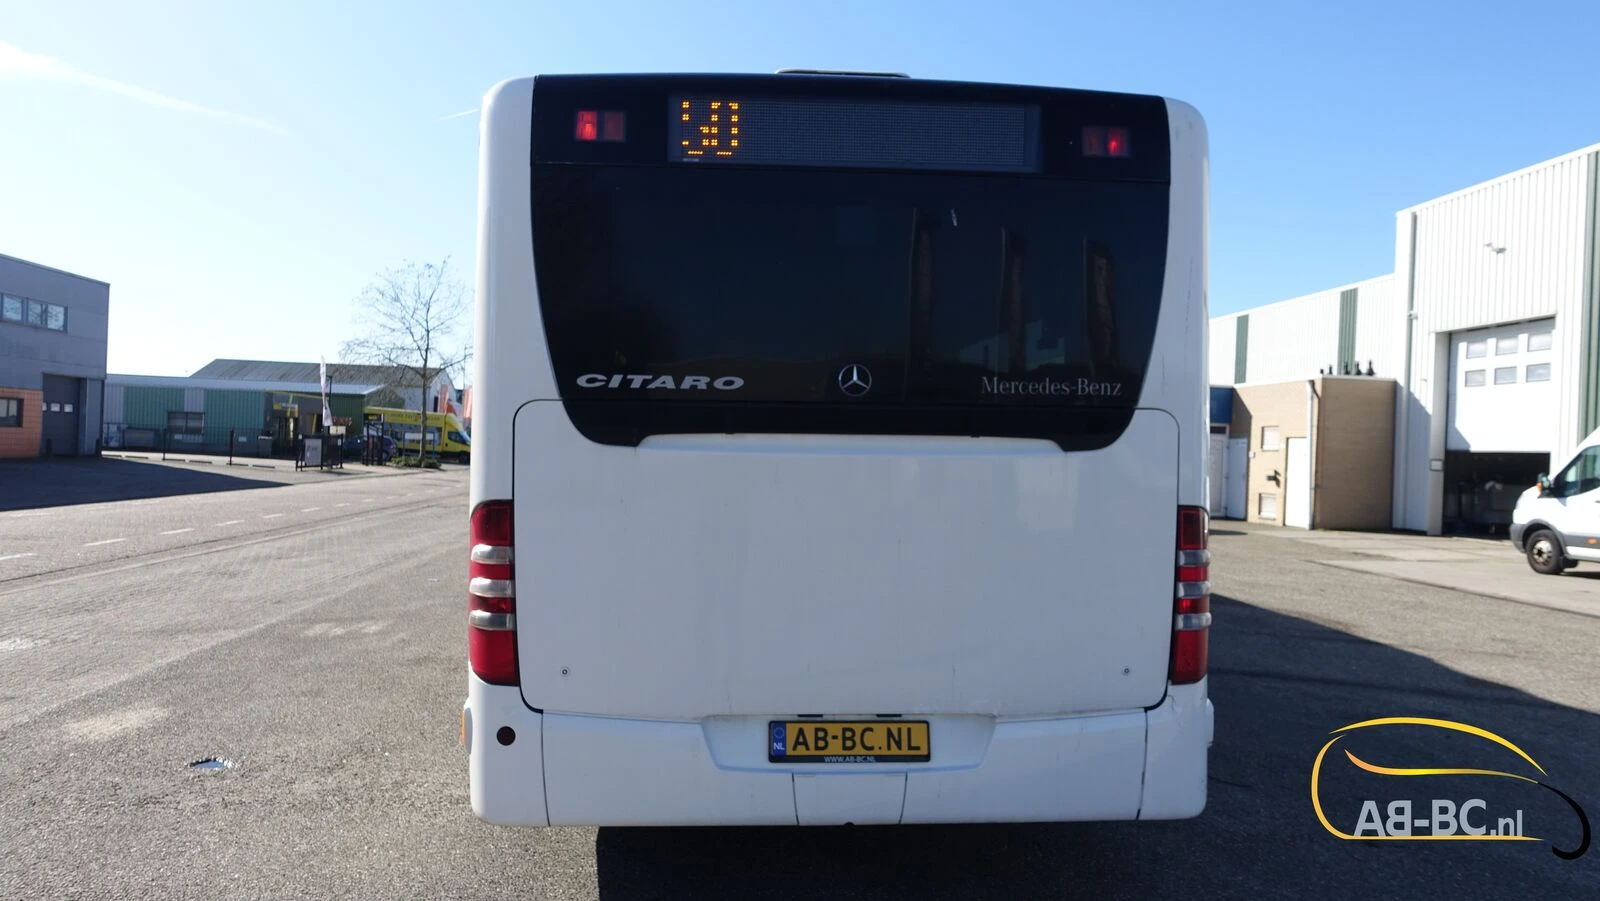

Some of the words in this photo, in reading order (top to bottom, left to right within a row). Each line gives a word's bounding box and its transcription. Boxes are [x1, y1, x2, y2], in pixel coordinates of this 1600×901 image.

[576, 373, 744, 390] CITARO
[981, 375, 1122, 396] Mercedes-Benz
[773, 742, 785, 750] NL
[792, 727, 921, 751] AB-BC.NL
